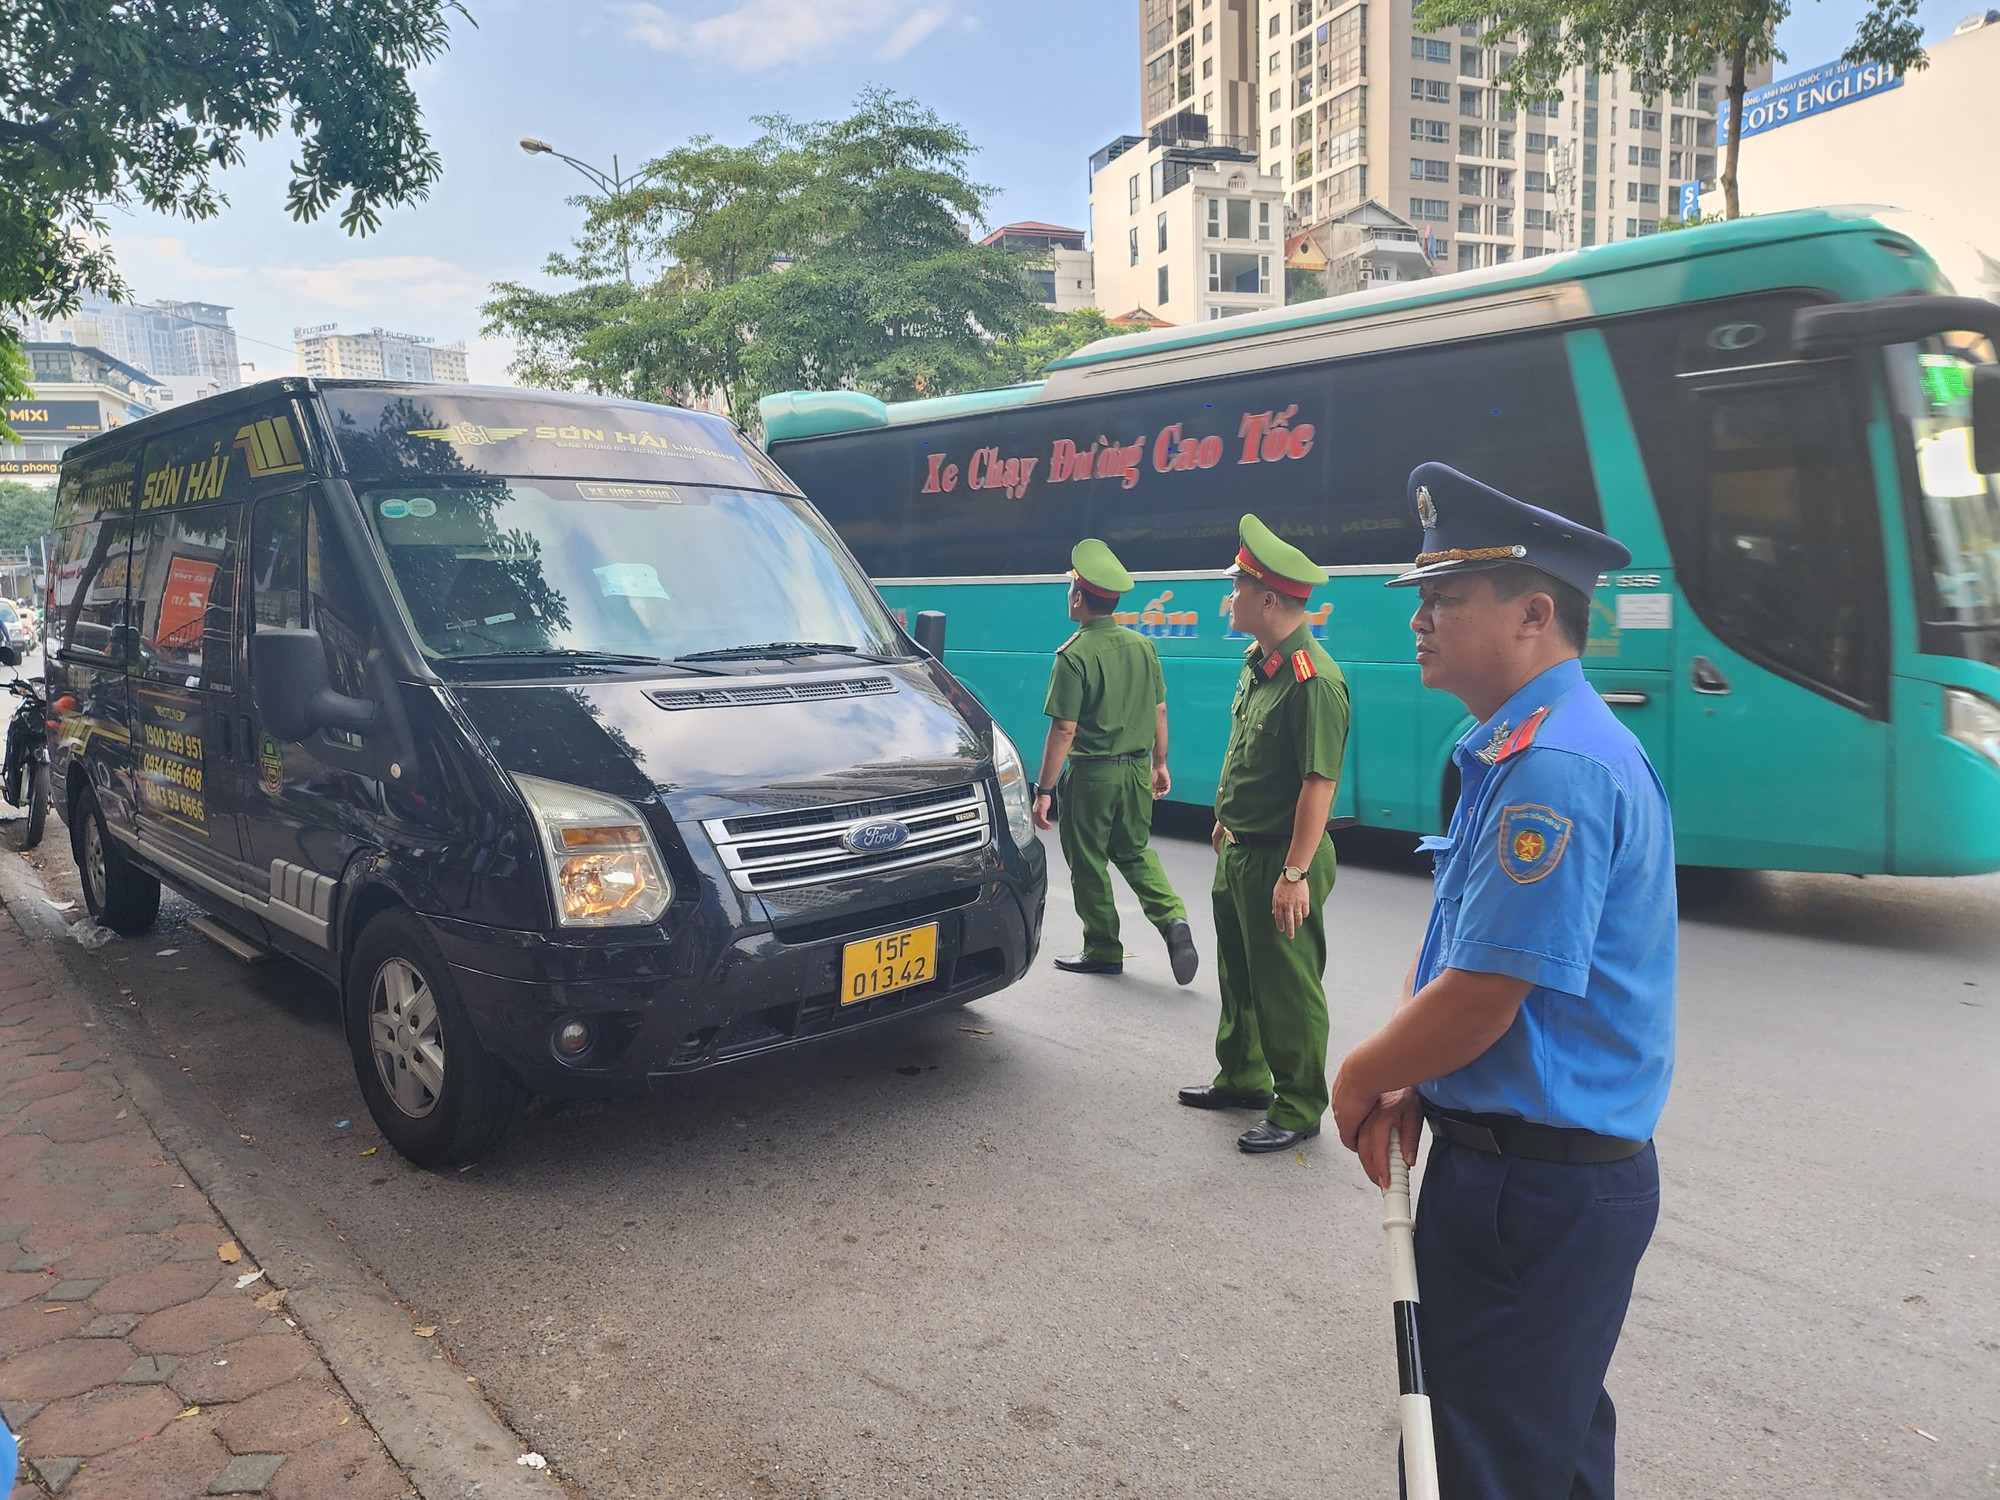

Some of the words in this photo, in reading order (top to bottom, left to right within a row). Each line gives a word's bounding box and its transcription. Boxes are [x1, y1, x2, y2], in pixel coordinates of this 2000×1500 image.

[1763, 88, 1779, 102] ANH
[1796, 62, 1894, 114] ENGLISH
[10, 409, 49, 422] MIXI
[671, 443, 739, 464] LIMOUSINE
[921, 453, 958, 494] Xe
[967, 445, 1038, 500] Chạy
[1153, 422, 1223, 474] Cao
[1237, 404, 1316, 466] Tốc
[22, 463, 57, 474] phong
[140, 461, 185, 510] SƠN
[184, 441, 230, 503] HẢI
[1112, 590, 1198, 639] uấn
[145, 724, 165, 749] 1900
[166, 730, 184, 755] 299
[186, 735, 202, 760] 951
[166, 760, 183, 785] 666
[184, 766, 202, 792] 668
[167, 789, 180, 811] 59
[180, 793, 204, 822] 6666
[864, 825, 898, 846] Ford
[874, 934, 912, 965] 15F
[853, 956, 926, 998] 013.42
